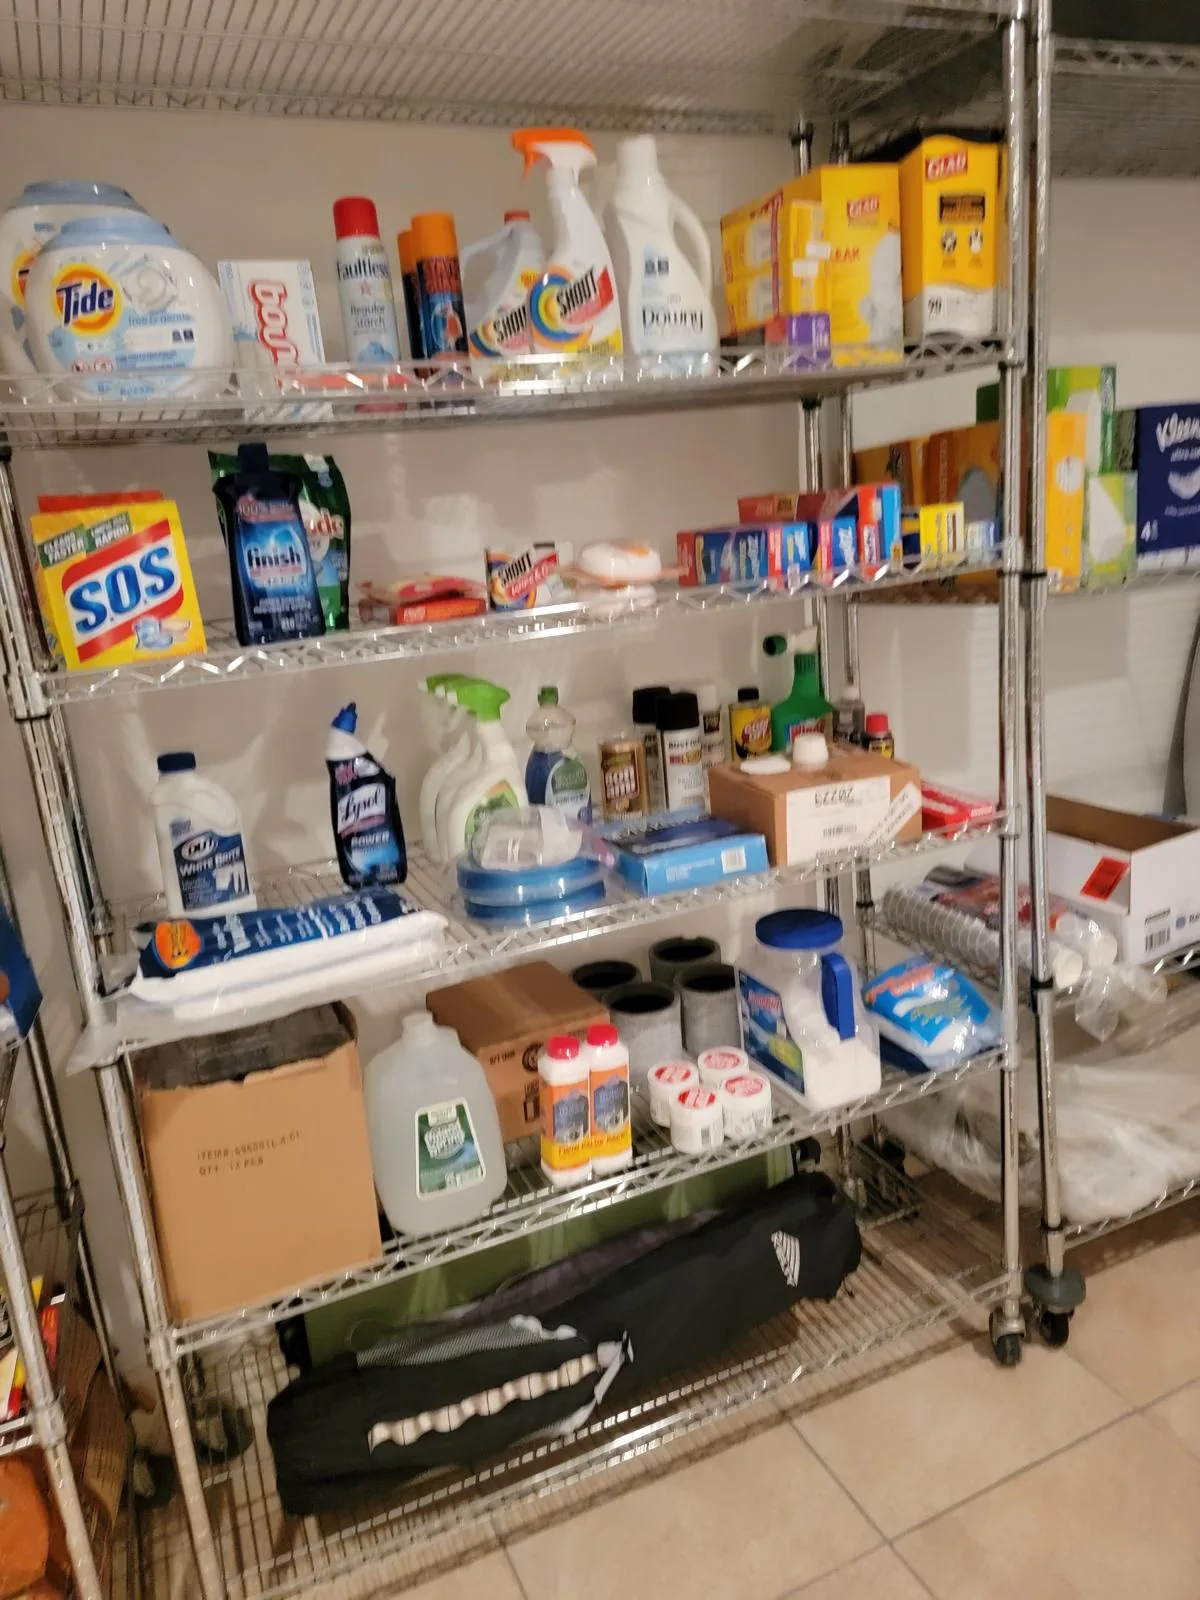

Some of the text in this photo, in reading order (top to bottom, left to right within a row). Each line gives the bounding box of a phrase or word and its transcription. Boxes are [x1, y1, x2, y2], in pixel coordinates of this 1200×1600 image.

[56, 281, 114, 327] Tide
[556, 267, 598, 316] SHOUT
[642, 307, 704, 334] Downy
[246, 545, 303, 571] finish
[341, 785, 382, 823] Lysol
